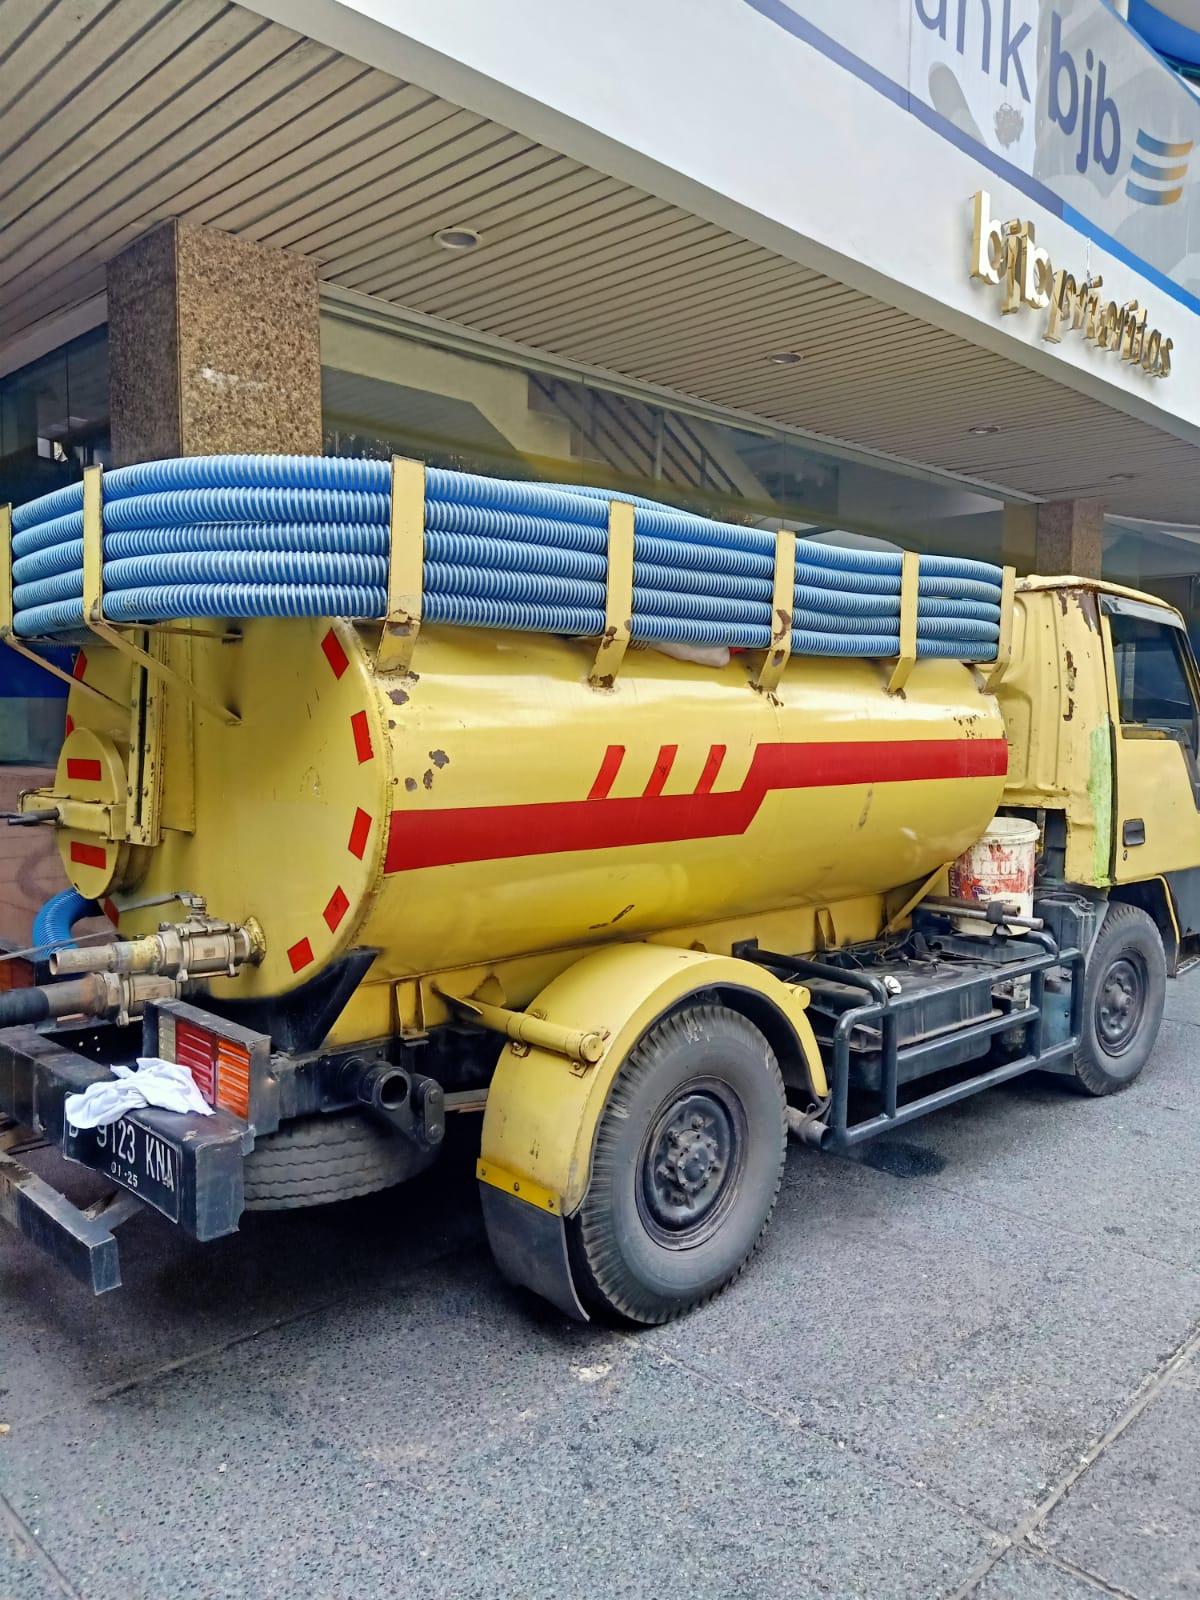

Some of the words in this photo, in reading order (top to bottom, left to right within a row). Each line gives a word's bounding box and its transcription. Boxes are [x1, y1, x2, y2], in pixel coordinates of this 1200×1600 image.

[1047, 10, 1121, 175] bjb
[970, 190, 1054, 316] bjb
[97, 1120, 135, 1164] 9123
[146, 1135, 174, 1192] KNA
